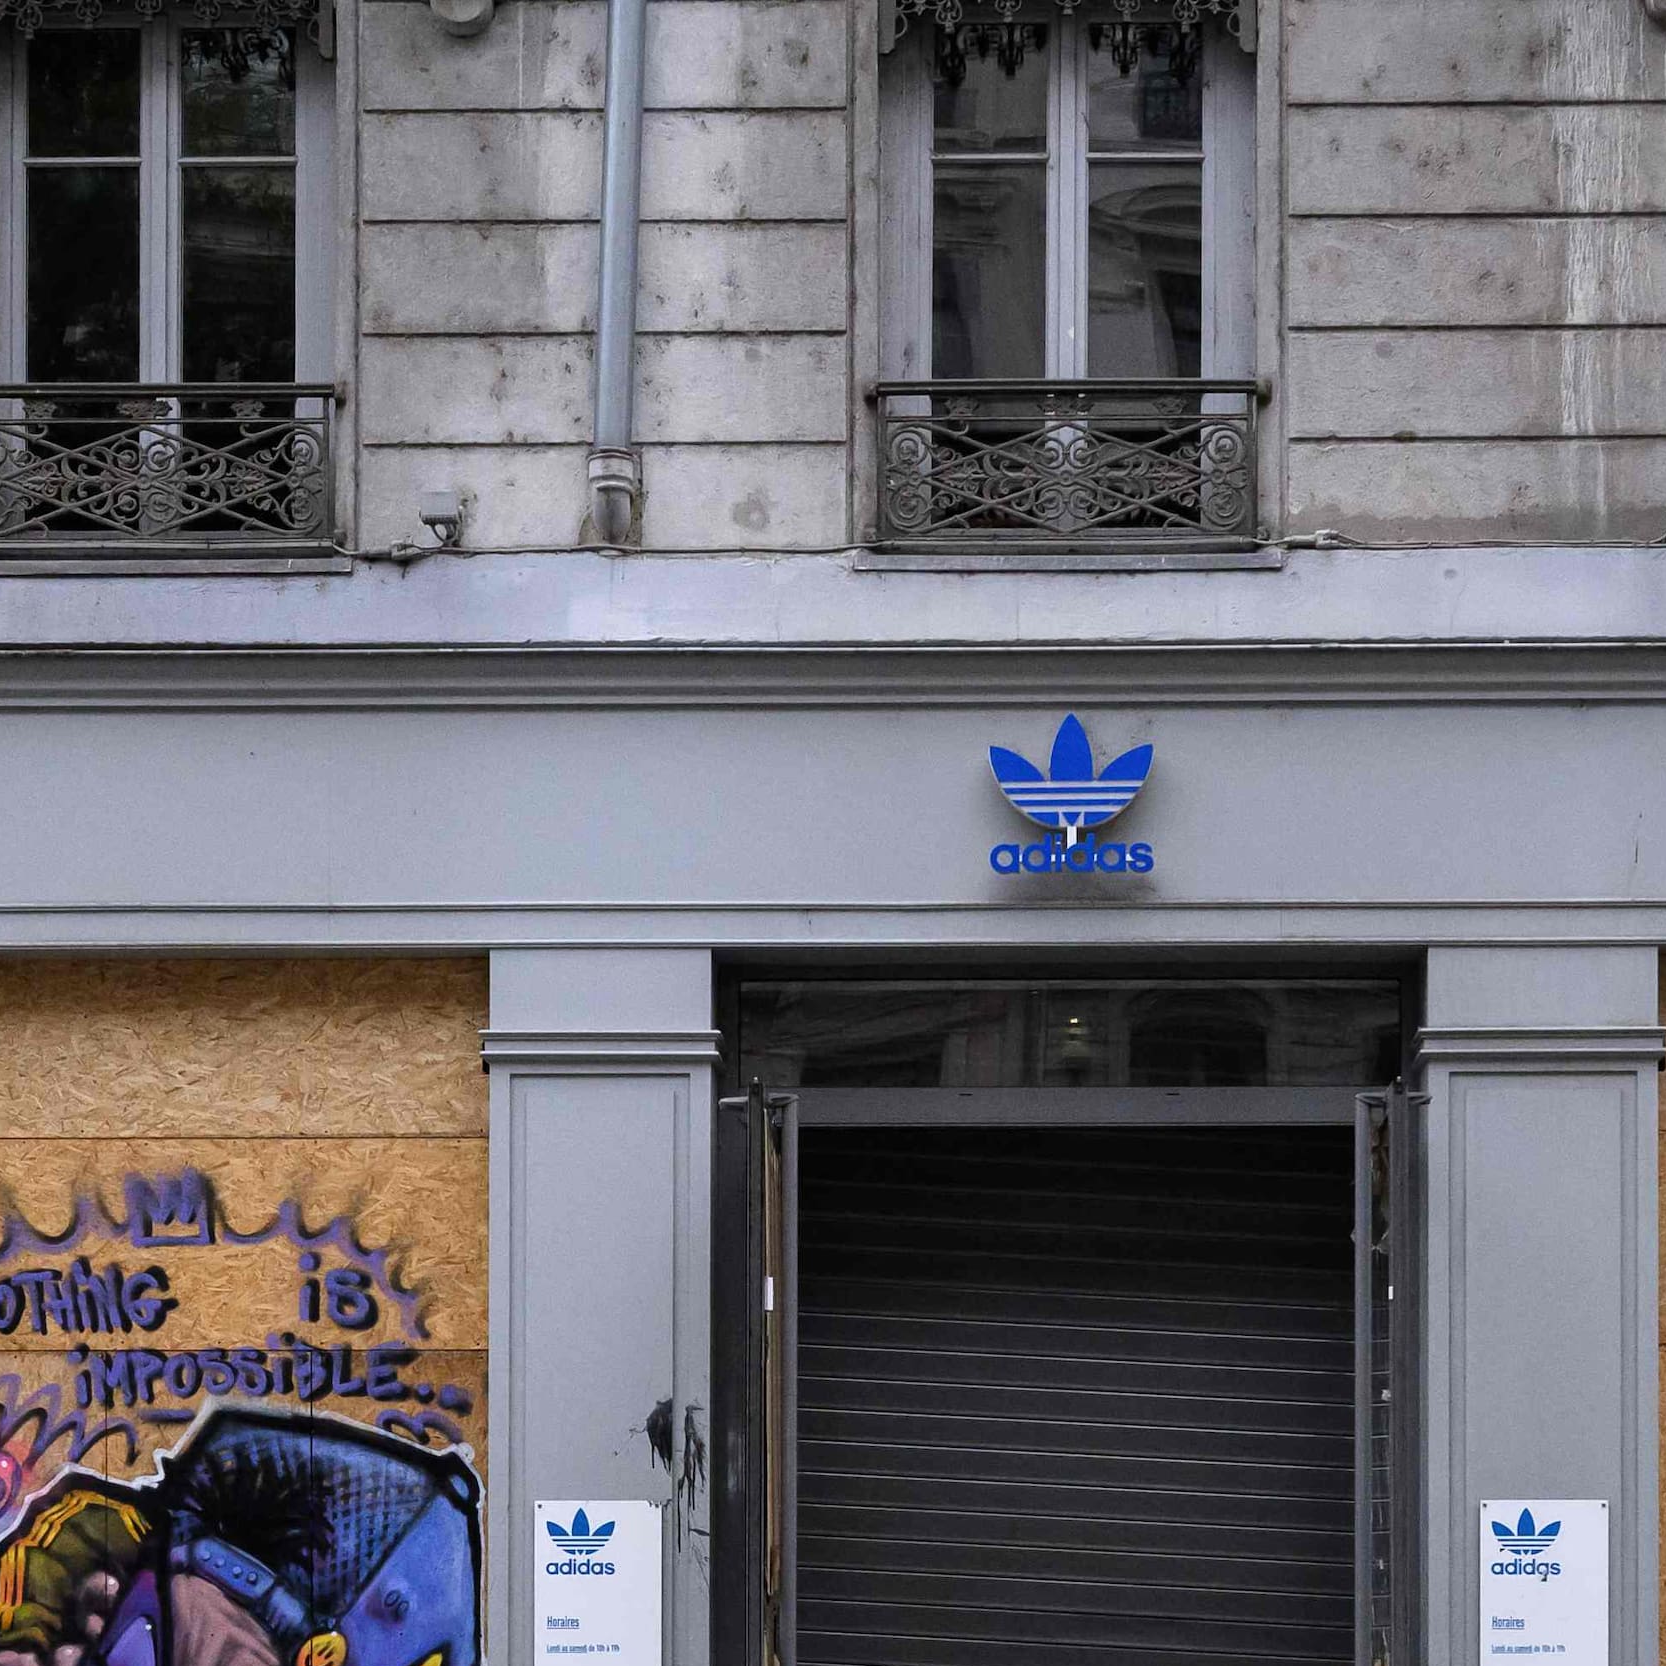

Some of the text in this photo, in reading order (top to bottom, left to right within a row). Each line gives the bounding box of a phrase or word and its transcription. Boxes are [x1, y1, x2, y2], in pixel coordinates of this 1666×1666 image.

[989, 833, 1155, 874] adidas
[546, 1558, 615, 1575] adidas
[547, 1616, 580, 1627] Horaires
[1492, 1616, 1525, 1628] Horaires
